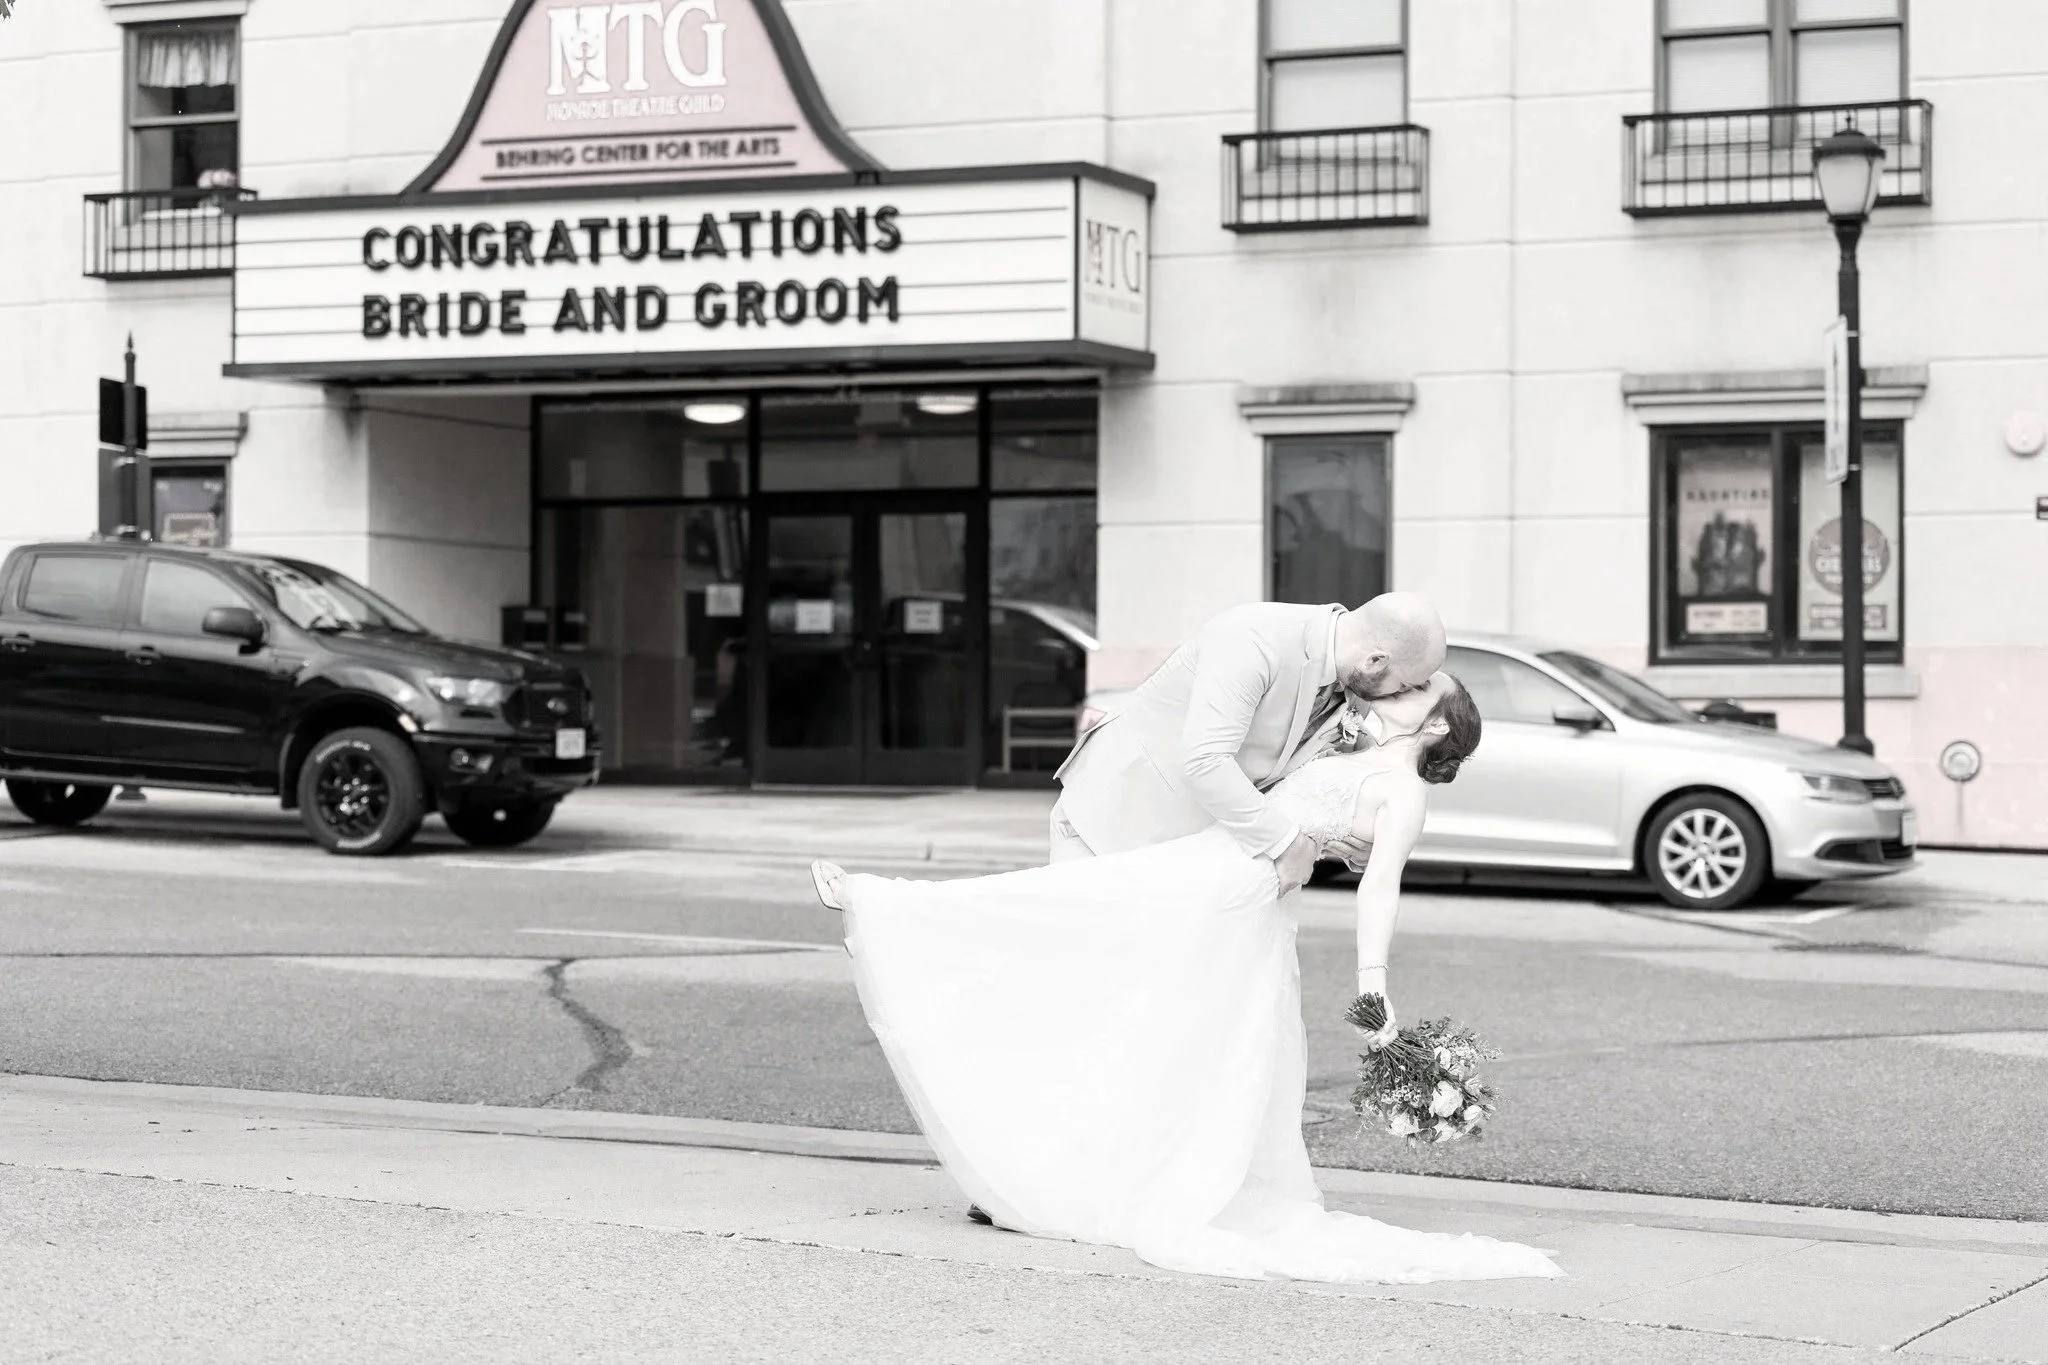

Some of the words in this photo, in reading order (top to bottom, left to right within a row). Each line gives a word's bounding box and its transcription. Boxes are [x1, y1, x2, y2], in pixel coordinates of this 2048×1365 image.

[547, 0, 728, 95] MTG
[496, 147, 574, 168] BEHRING
[582, 143, 648, 163] CENTER
[656, 140, 690, 160] FOR
[698, 138, 730, 158] THE
[735, 137, 780, 157] ARTS
[363, 206, 901, 270] CONGRATULATIONS
[1085, 219, 1140, 293] MTG
[363, 290, 526, 338] BRIDE
[554, 285, 667, 332] AND
[695, 276, 898, 328] GROOM
